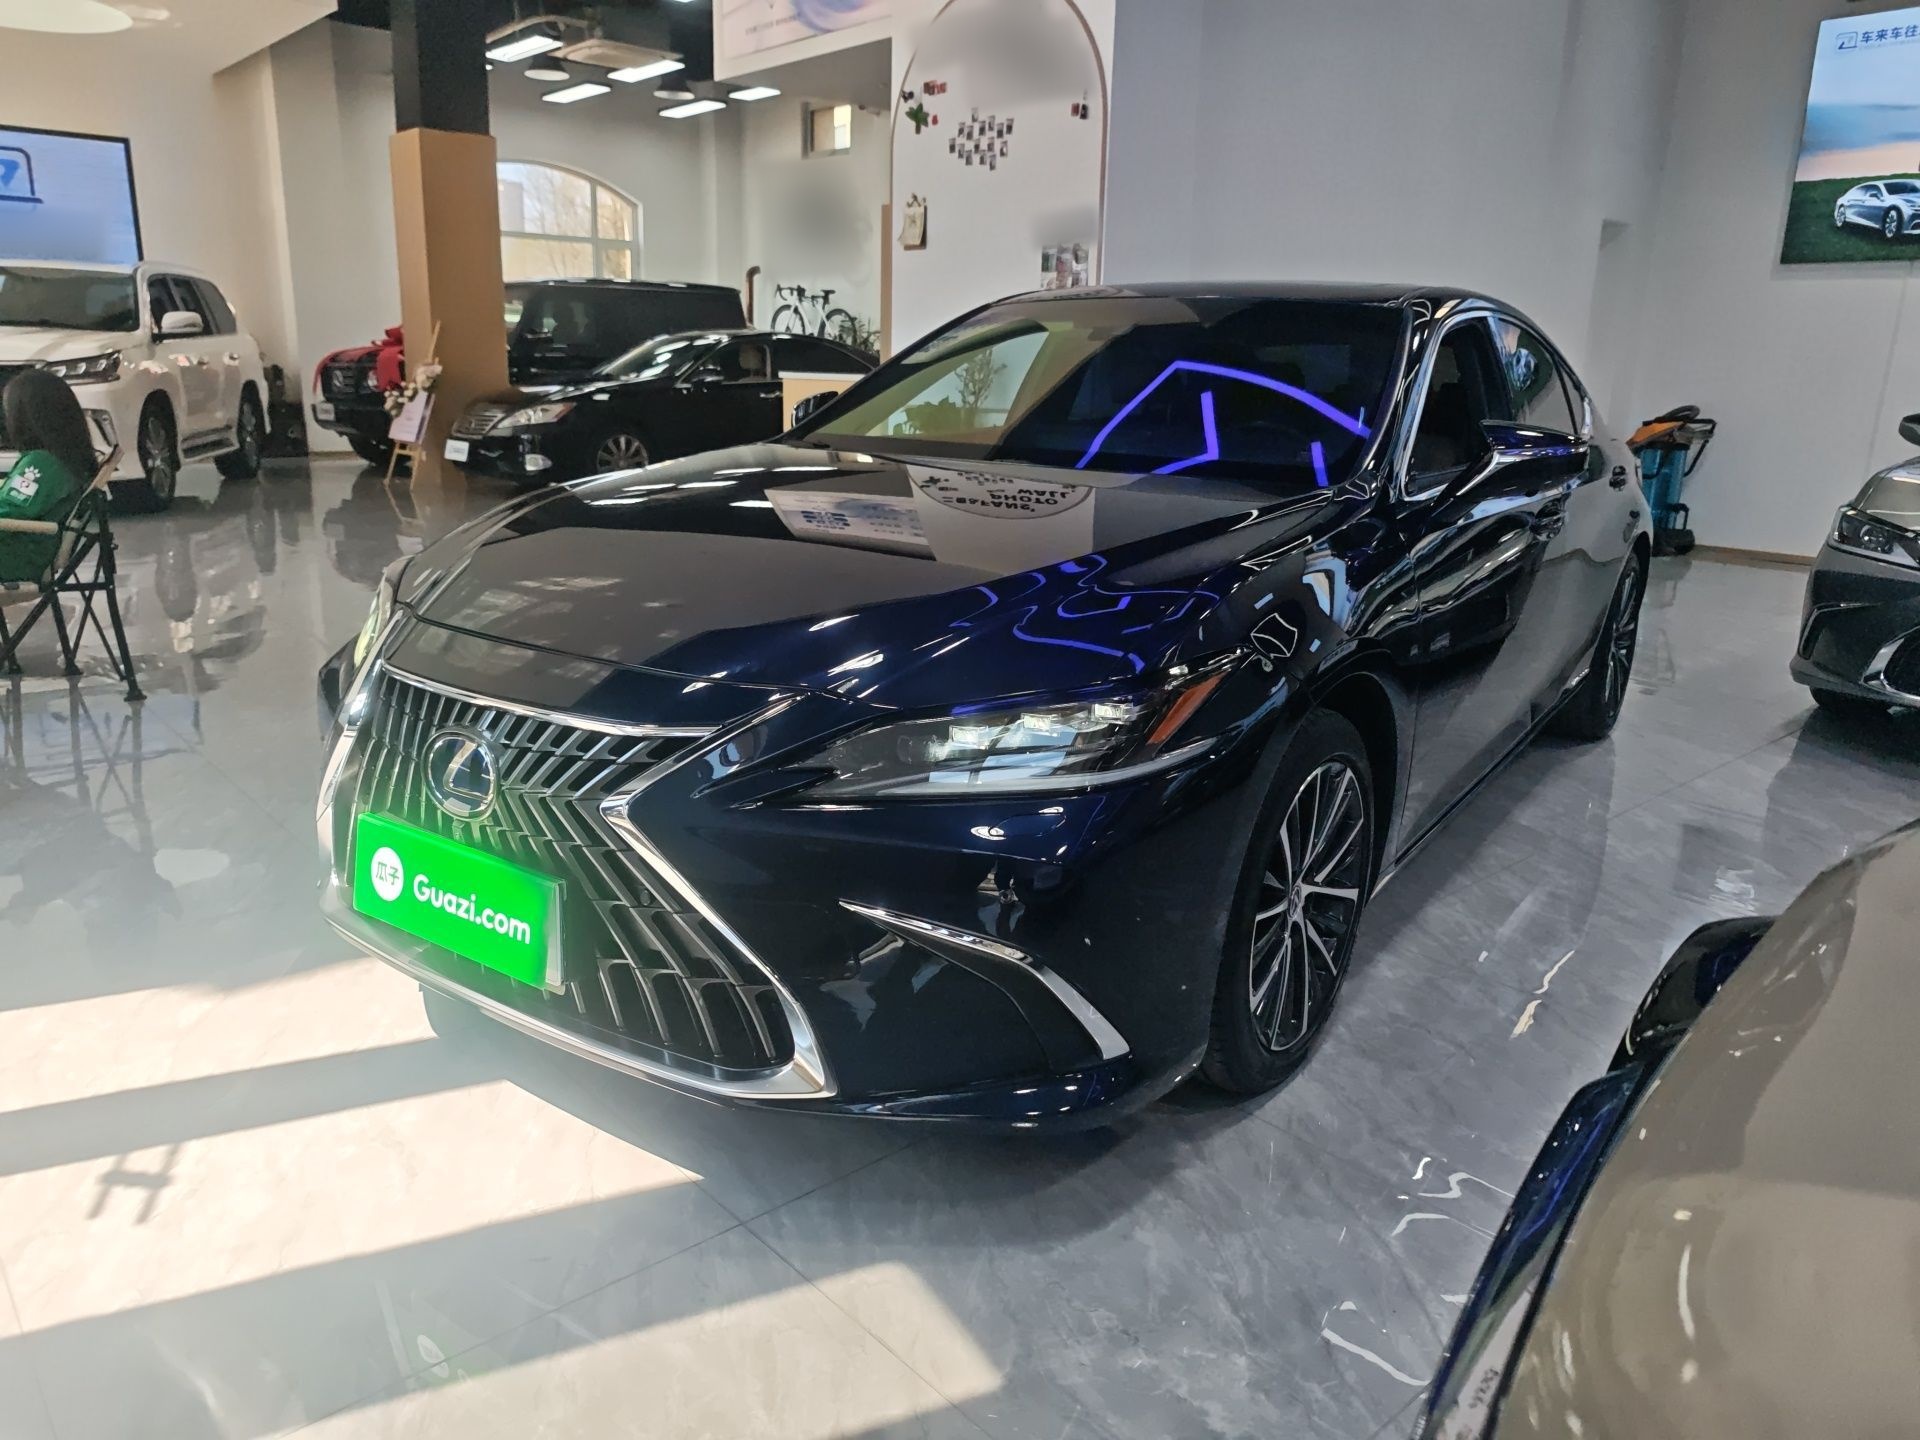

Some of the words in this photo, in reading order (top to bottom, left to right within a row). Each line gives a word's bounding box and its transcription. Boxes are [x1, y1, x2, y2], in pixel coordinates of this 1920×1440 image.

[1860, 24, 1920, 43] 车来车往
[375, 860, 400, 886] 瓜子
[413, 873, 531, 945] Guazi.com
